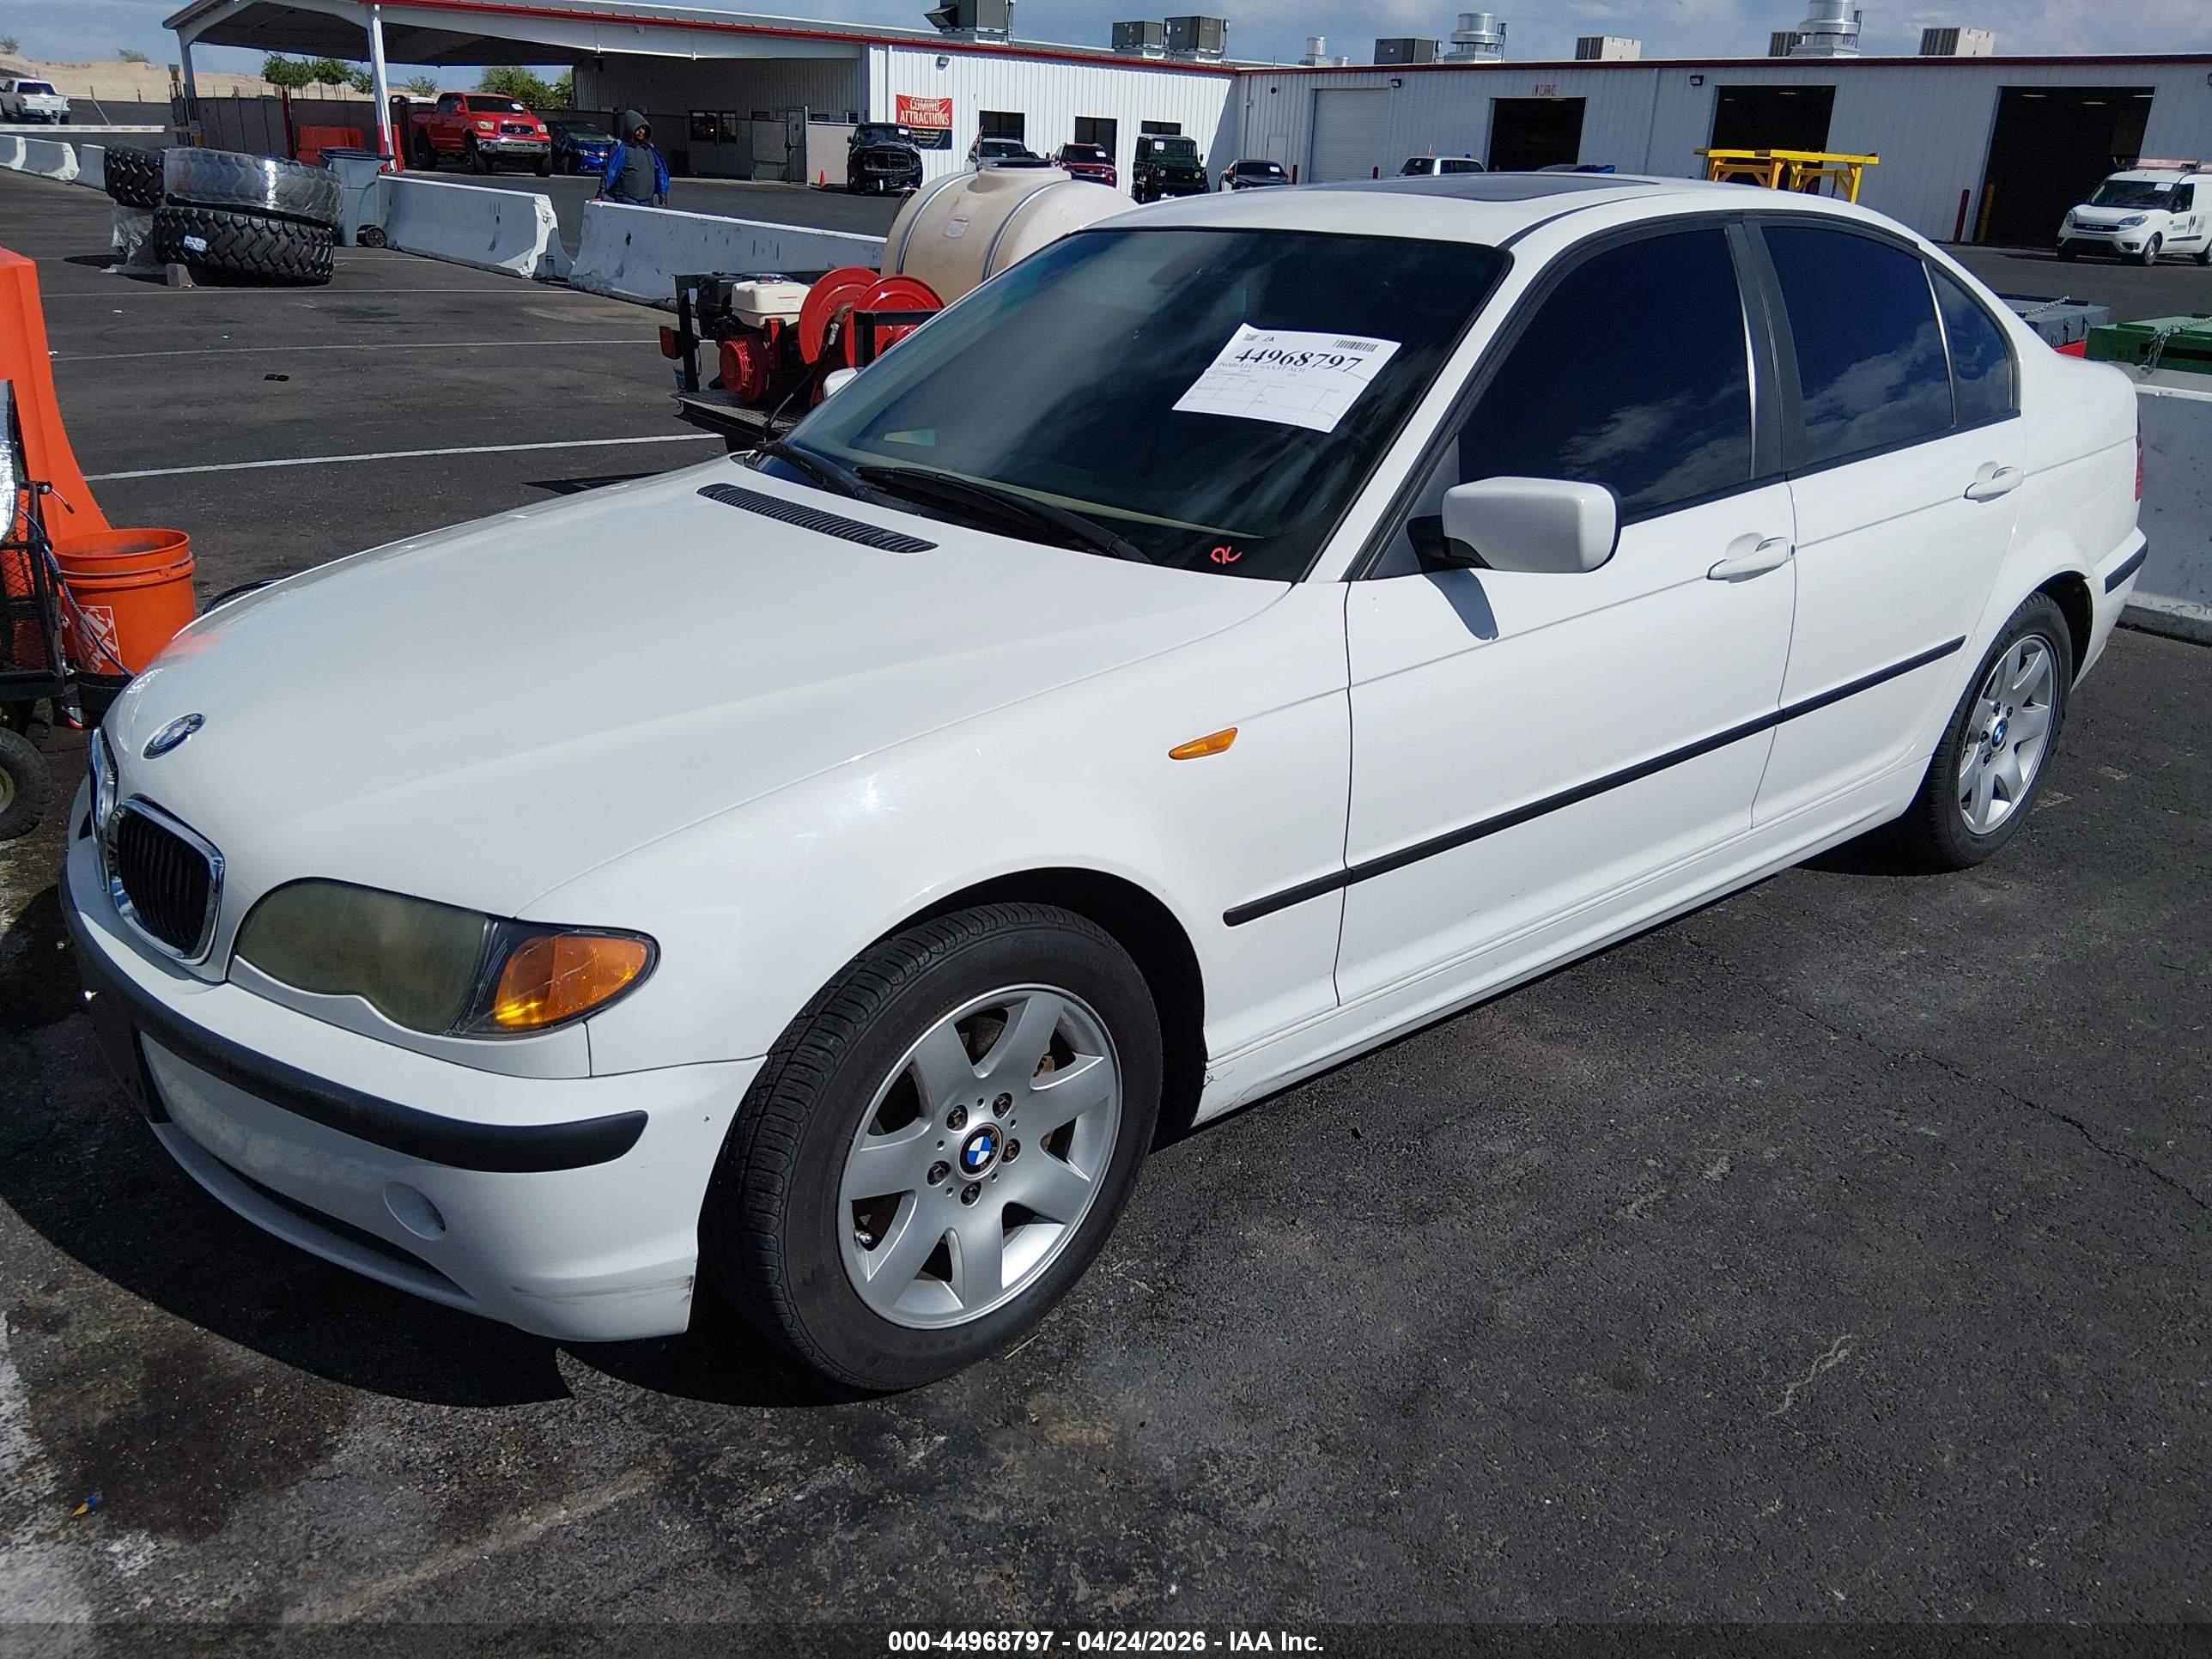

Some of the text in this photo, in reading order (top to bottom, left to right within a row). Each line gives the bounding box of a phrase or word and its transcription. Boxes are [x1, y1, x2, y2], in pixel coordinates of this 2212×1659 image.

[910, 98, 939, 112] COMING
[899, 110, 949, 125] ATTRACTIONS
[1235, 349, 1364, 372] 44968797
